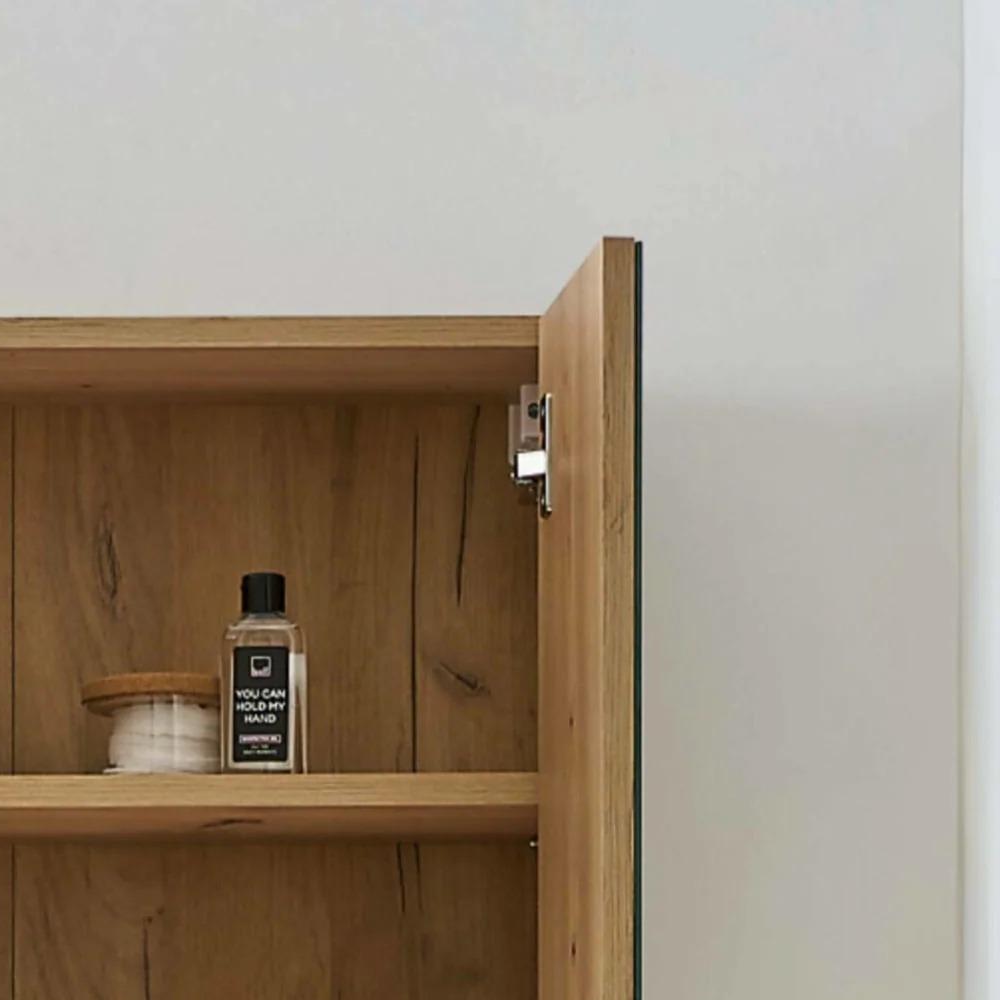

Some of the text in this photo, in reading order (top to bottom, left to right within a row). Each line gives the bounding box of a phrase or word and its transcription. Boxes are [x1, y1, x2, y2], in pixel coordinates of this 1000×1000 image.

[236, 688, 286, 699] YOU CAN
[236, 701, 286, 711] HOLD MY
[243, 714, 277, 723] HAND
